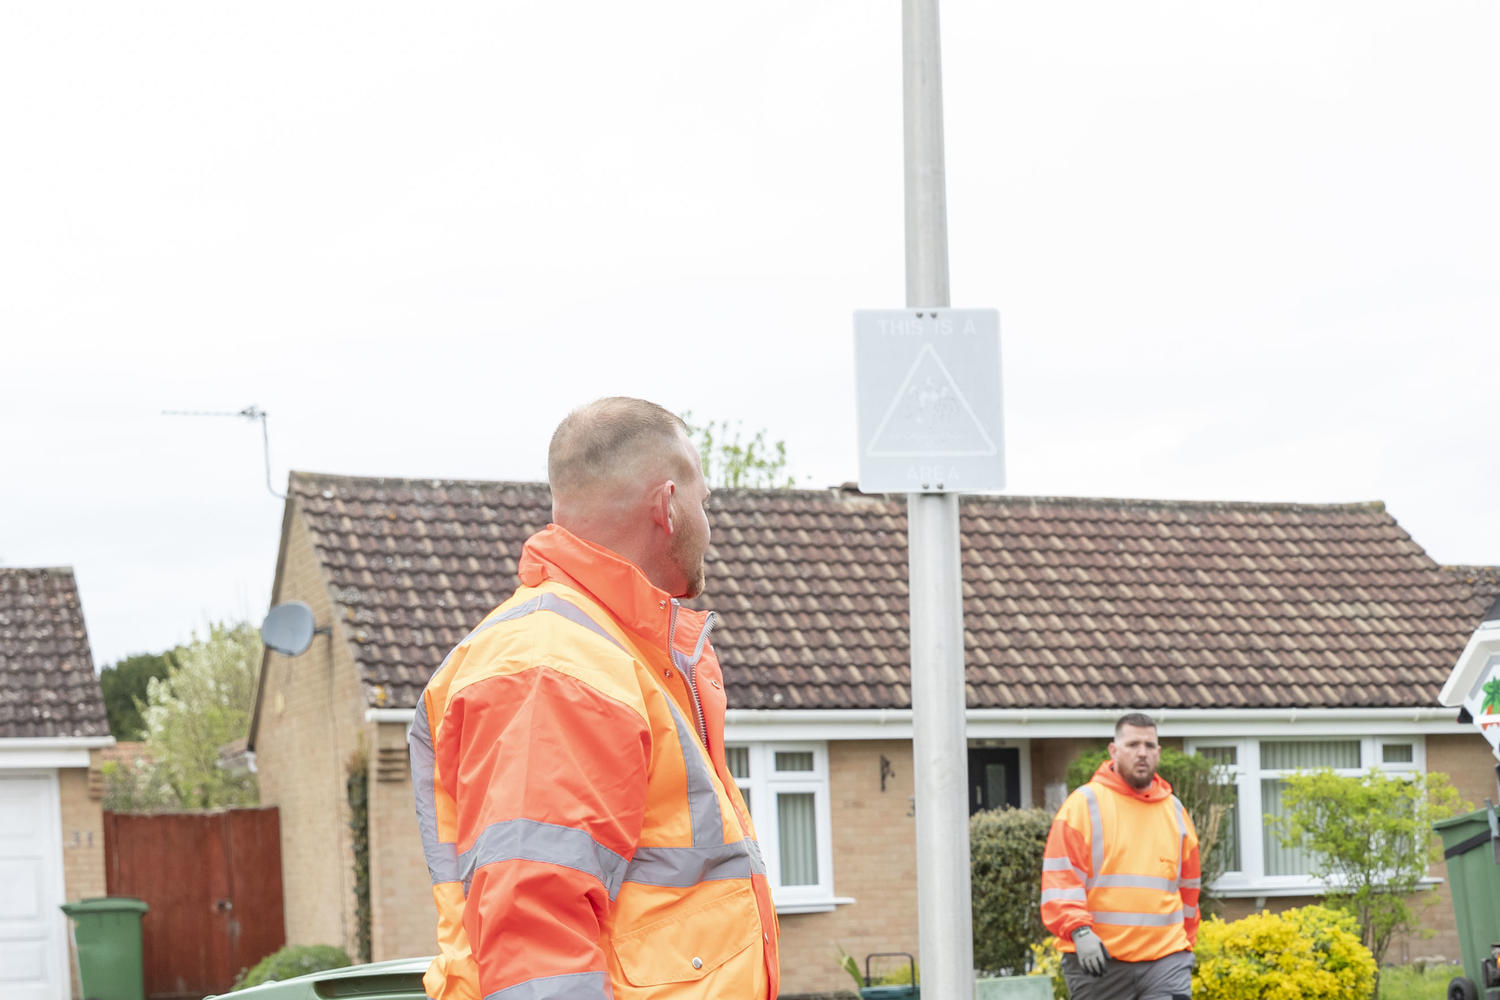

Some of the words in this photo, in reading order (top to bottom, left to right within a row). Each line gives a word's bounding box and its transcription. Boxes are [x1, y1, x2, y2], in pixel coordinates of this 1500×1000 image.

[877, 319, 923, 336] THIS
[934, 319, 953, 336] IS
[963, 319, 977, 336] A
[906, 465, 960, 481] AREA
